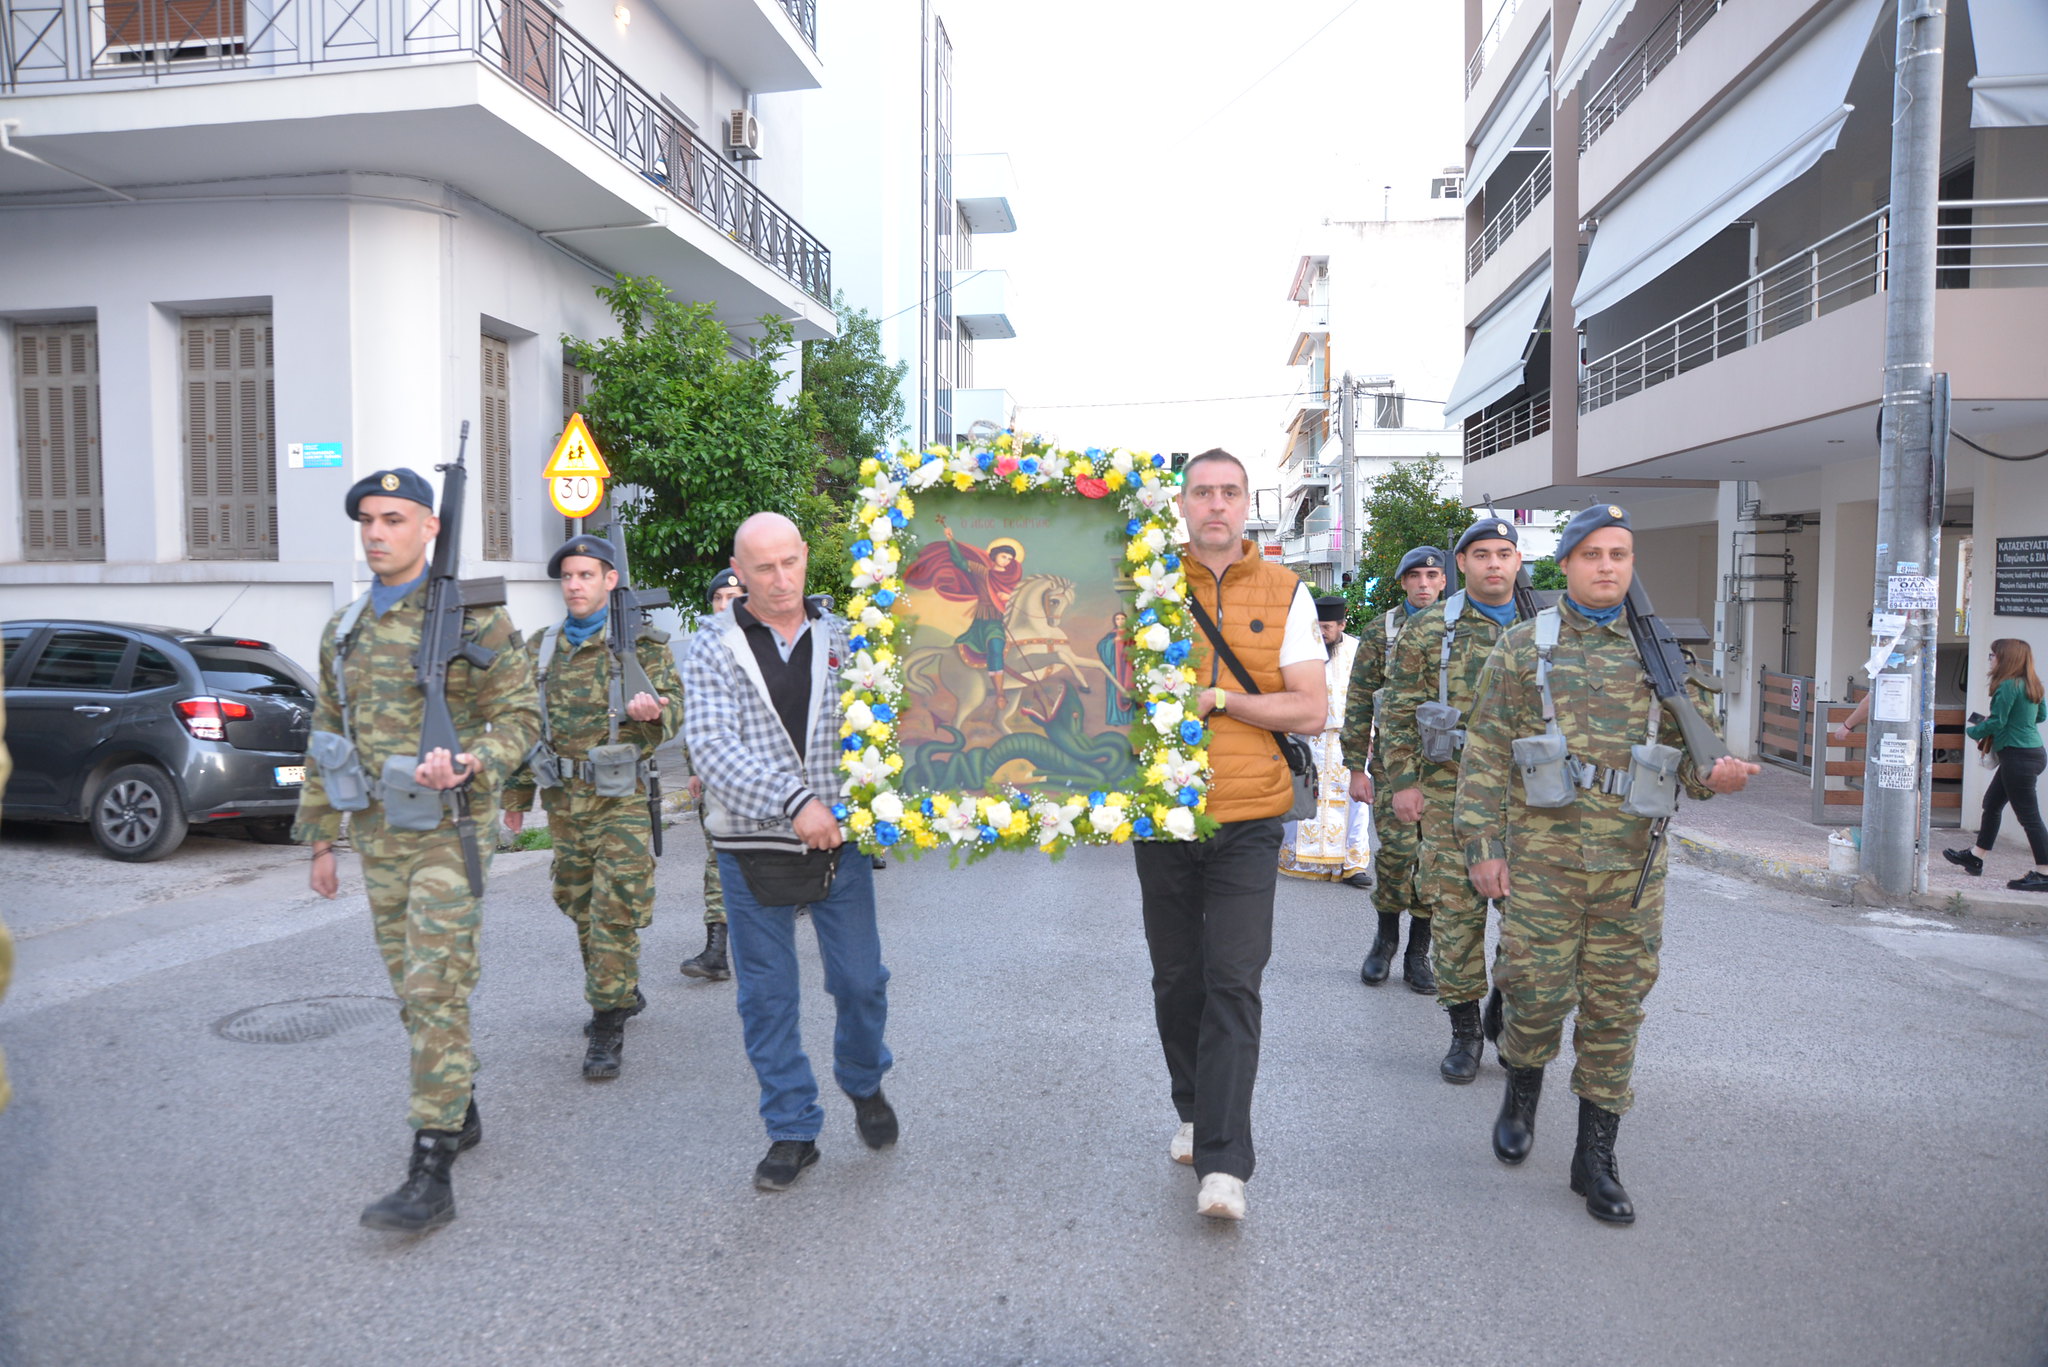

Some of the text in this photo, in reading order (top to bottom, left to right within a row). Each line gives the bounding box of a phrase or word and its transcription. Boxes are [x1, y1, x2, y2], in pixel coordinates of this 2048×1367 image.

[561, 477, 590, 499] 30
[1998, 540, 2048, 551] ΚΑΤΑΣΚΕΥΑΣΤ
[2030, 552, 2035, 562] &
